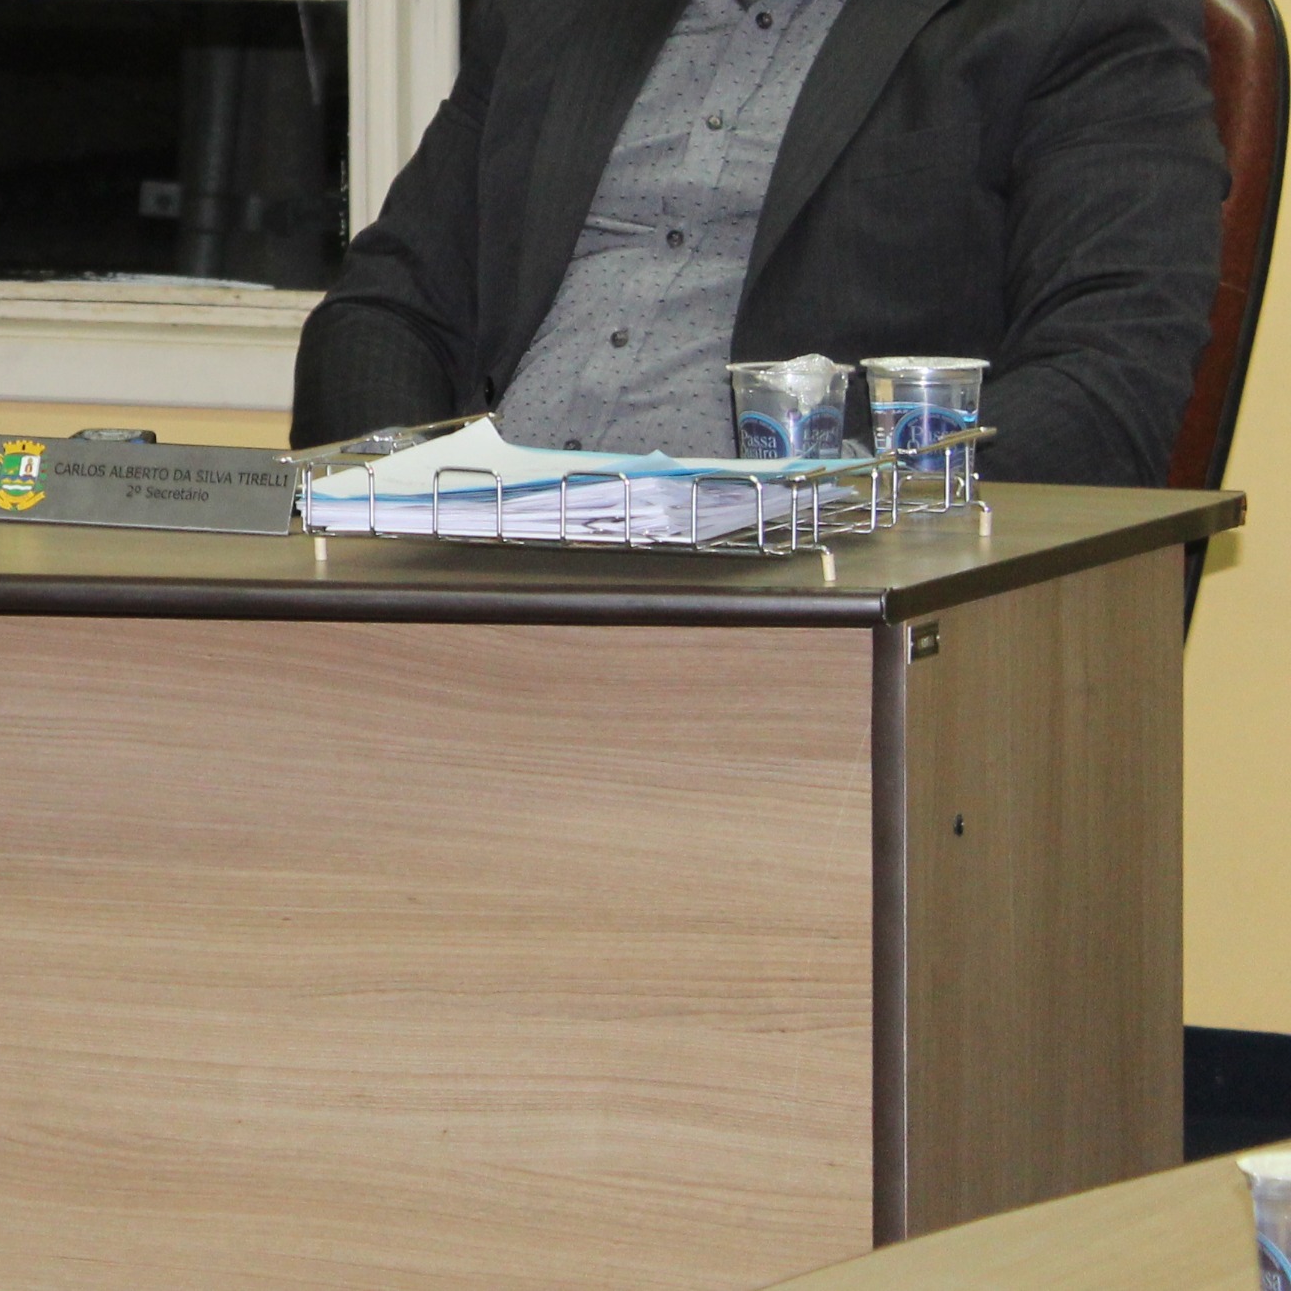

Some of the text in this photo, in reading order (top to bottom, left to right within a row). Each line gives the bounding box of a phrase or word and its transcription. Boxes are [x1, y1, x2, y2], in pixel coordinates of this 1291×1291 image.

[54, 462, 289, 488] CARLOS ALBERTO DA SILVA TIRELLI
[145, 485, 210, 502] Secretário
